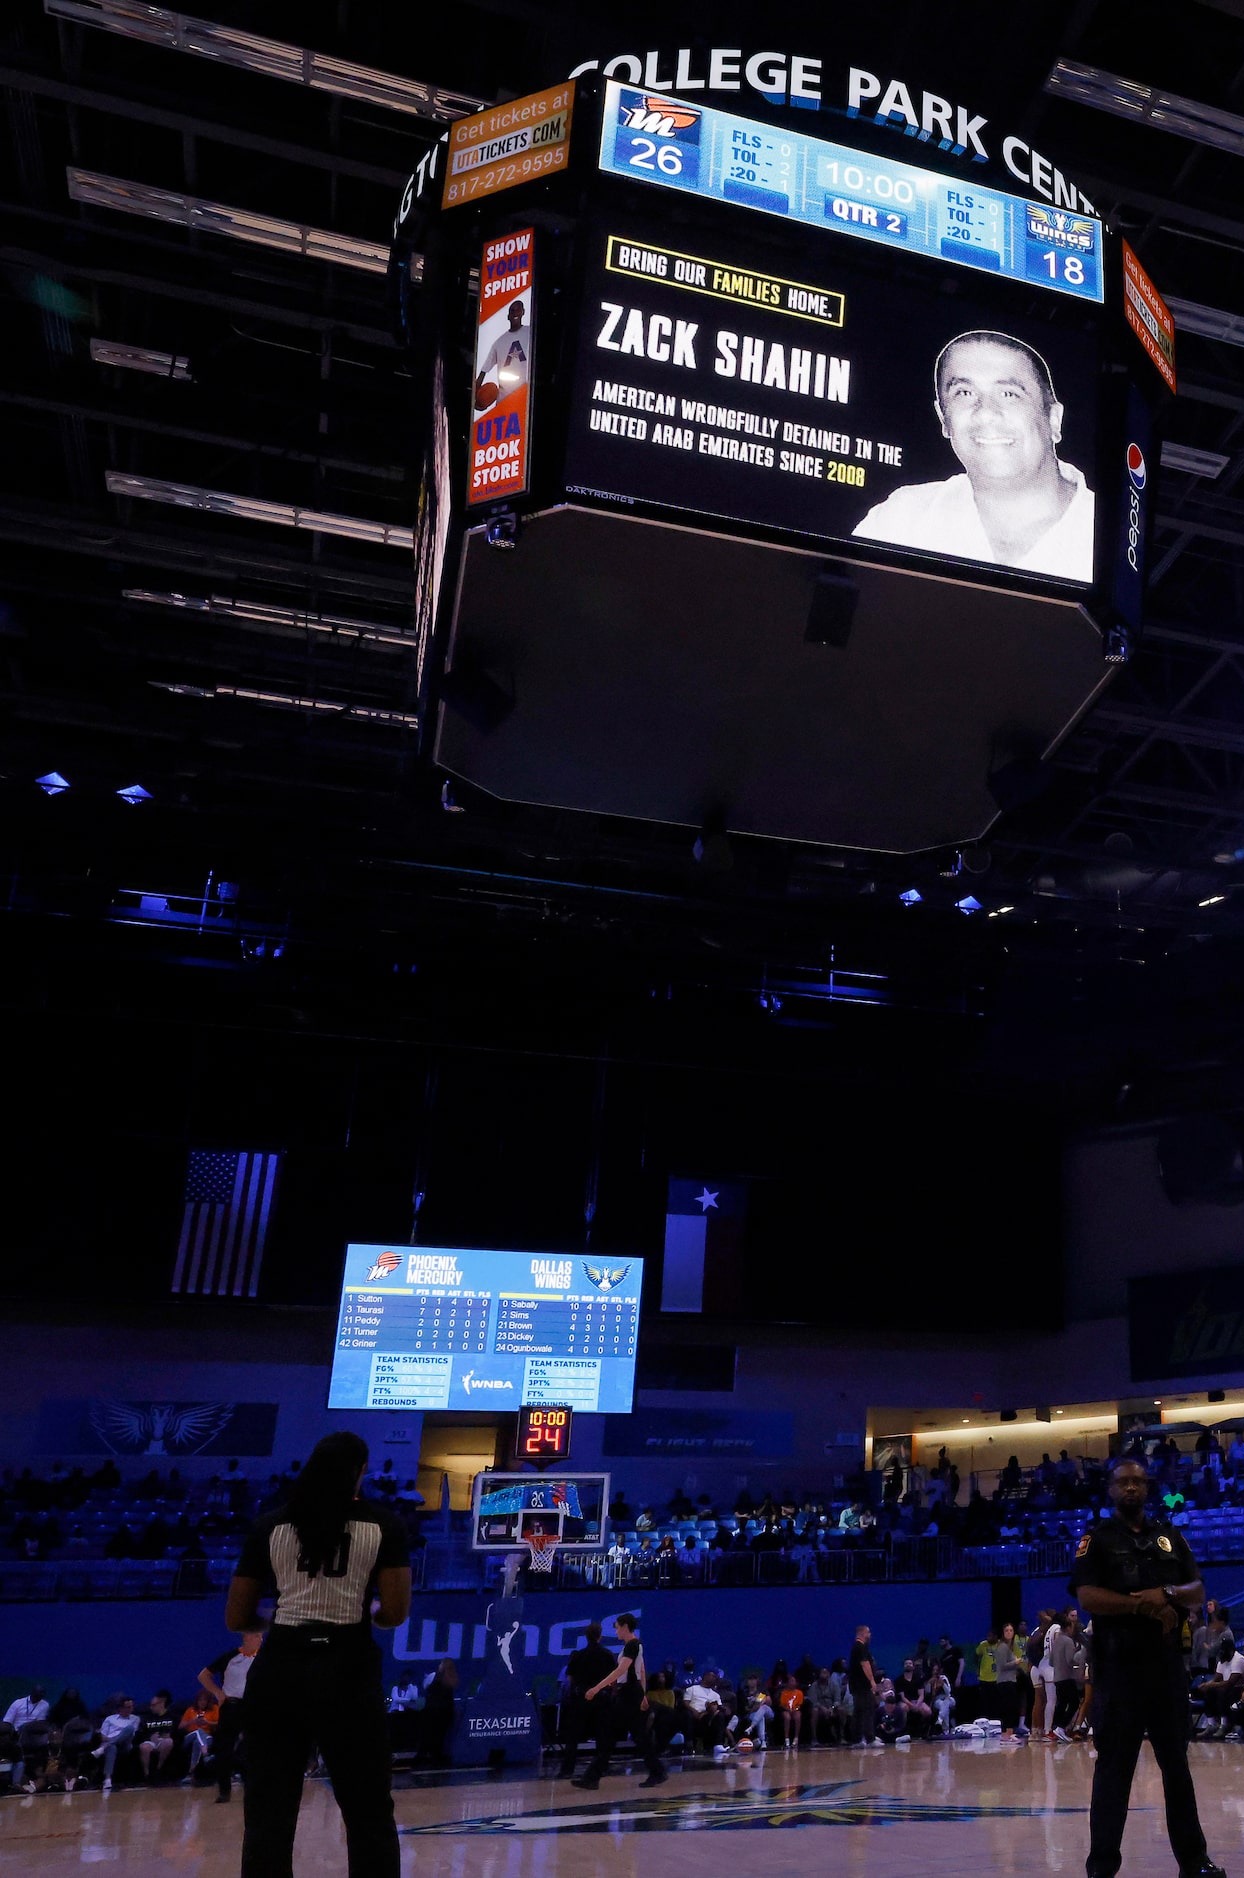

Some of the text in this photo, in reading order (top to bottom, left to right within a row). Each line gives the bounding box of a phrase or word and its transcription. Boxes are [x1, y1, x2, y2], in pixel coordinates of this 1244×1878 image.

[456, 90, 569, 143] Get tickets at
[848, 67, 991, 158] PARK
[457, 117, 561, 170] UTATICKETS.COM
[732, 129, 762, 149] FLS
[628, 135, 684, 176] 26
[731, 147, 760, 167] TOL
[447, 147, 565, 201] 817-272-9595
[729, 166, 756, 183] :20
[826, 162, 914, 204] 10:00
[947, 190, 974, 209] FLS
[832, 199, 901, 233] QTR 2
[947, 207, 973, 226] TOL
[947, 226, 971, 242] :20
[485, 233, 531, 263] SHOW
[487, 252, 529, 280] YOUR
[1043, 250, 1085, 286] 18
[484, 270, 529, 299] SPIRIT
[617, 245, 833, 320] BRING OUR FAMILIES HOME.
[596, 301, 851, 404] ZACK SHAHIN
[476, 411, 522, 447] UTA
[592, 379, 903, 468] AMERICAN WRONGFULLY DETAINED IN THE
[474, 438, 520, 468] BOOK
[589, 409, 866, 488] UNITED ARAB EMIRATES SINCE 2008
[473, 460, 519, 489] STORE
[565, 484, 635, 505] DAKTRONICS
[408, 1255, 457, 1271] PHOENIX
[531, 1260, 572, 1274] DALLAS
[406, 1270, 463, 1286] MERCURY
[535, 1274, 571, 1289] WINGS
[357, 1295, 382, 1303] Sutton
[511, 1301, 538, 1310] Sabally
[357, 1306, 384, 1314] Taurasi
[510, 1311, 529, 1319] Sims
[355, 1317, 381, 1326] Peddy
[354, 1328, 378, 1336] Turner
[508, 1333, 534, 1342] Dickey
[352, 1340, 376, 1348] Griner
[507, 1344, 552, 1353] Ogunbowale
[470, 1379, 513, 1390] WNBA
[530, 1411, 565, 1426] 10:00
[526, 1427, 560, 1453] 24
